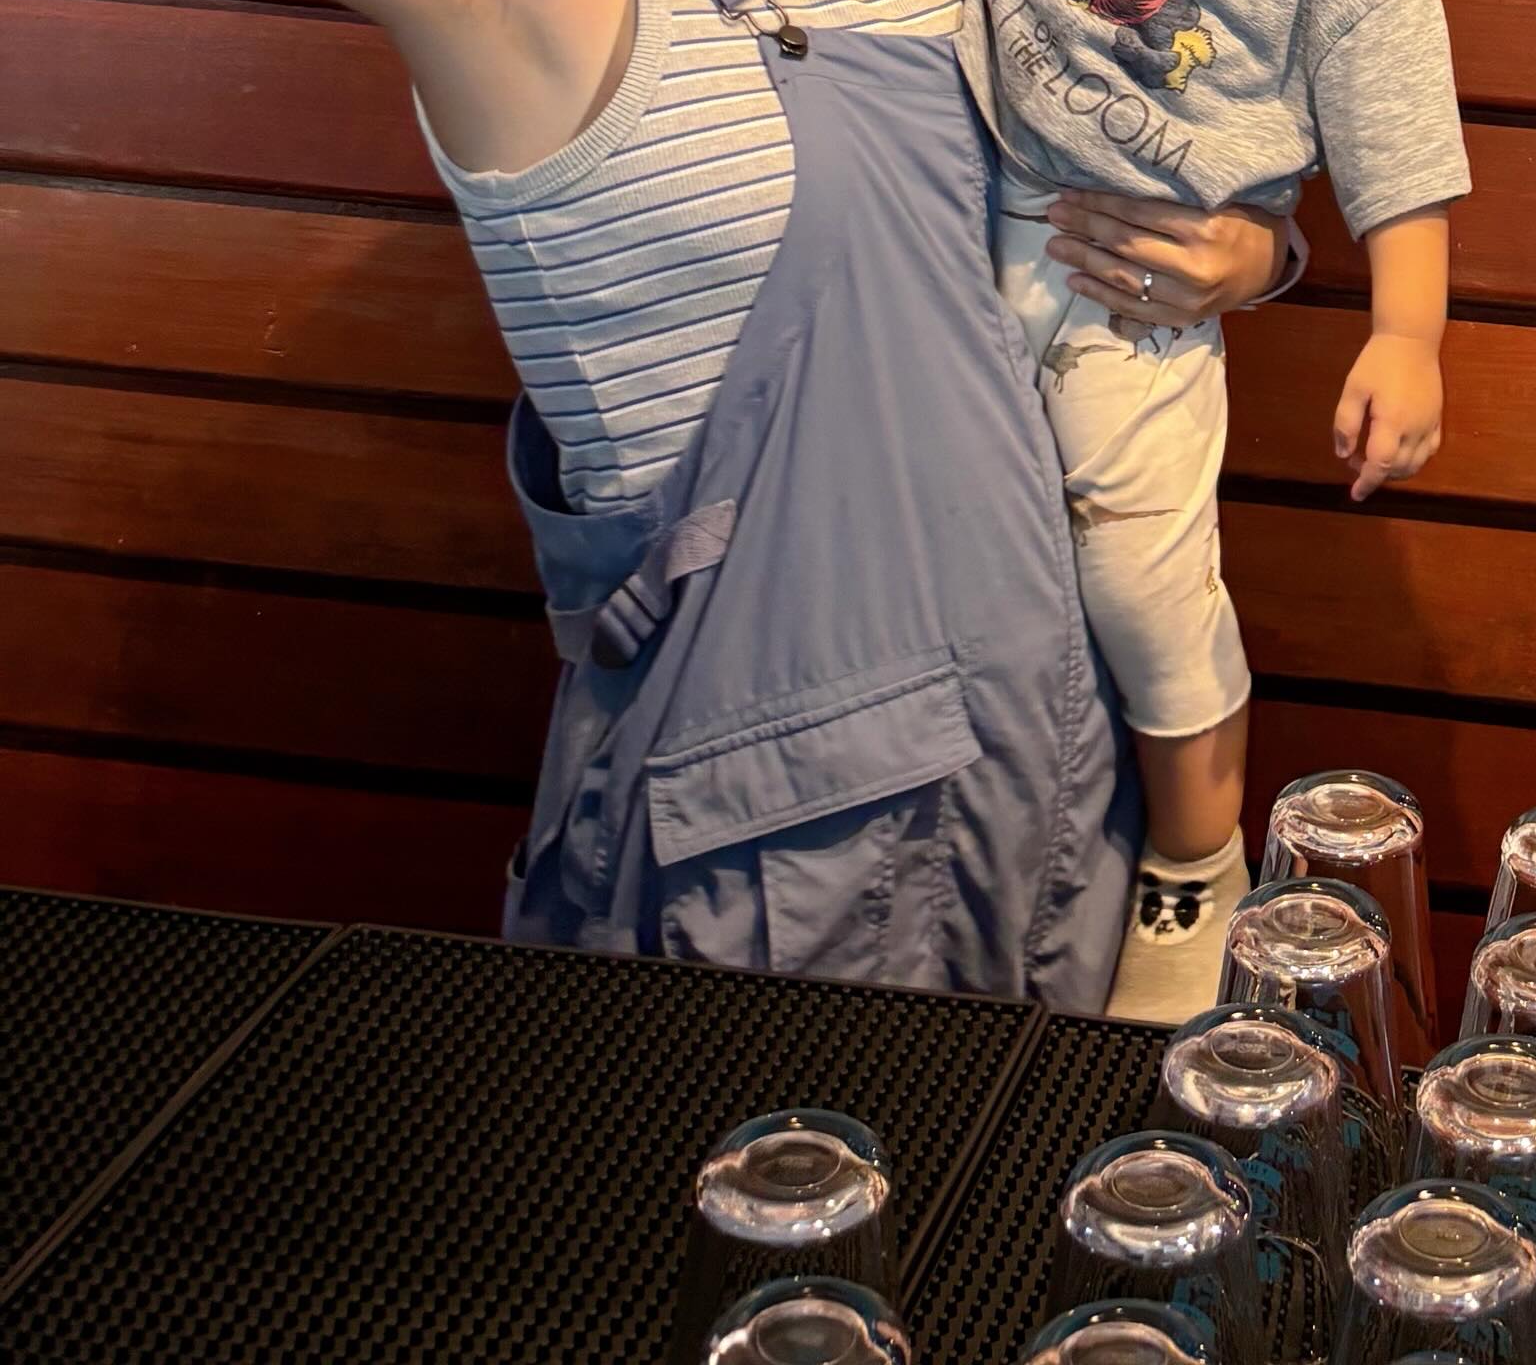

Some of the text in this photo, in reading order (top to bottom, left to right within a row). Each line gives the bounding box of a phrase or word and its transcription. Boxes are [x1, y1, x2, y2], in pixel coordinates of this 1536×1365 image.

[1008, 30, 1051, 77] THE
[1034, 20, 1059, 52] OF
[1042, 53, 1196, 176] LOOM
